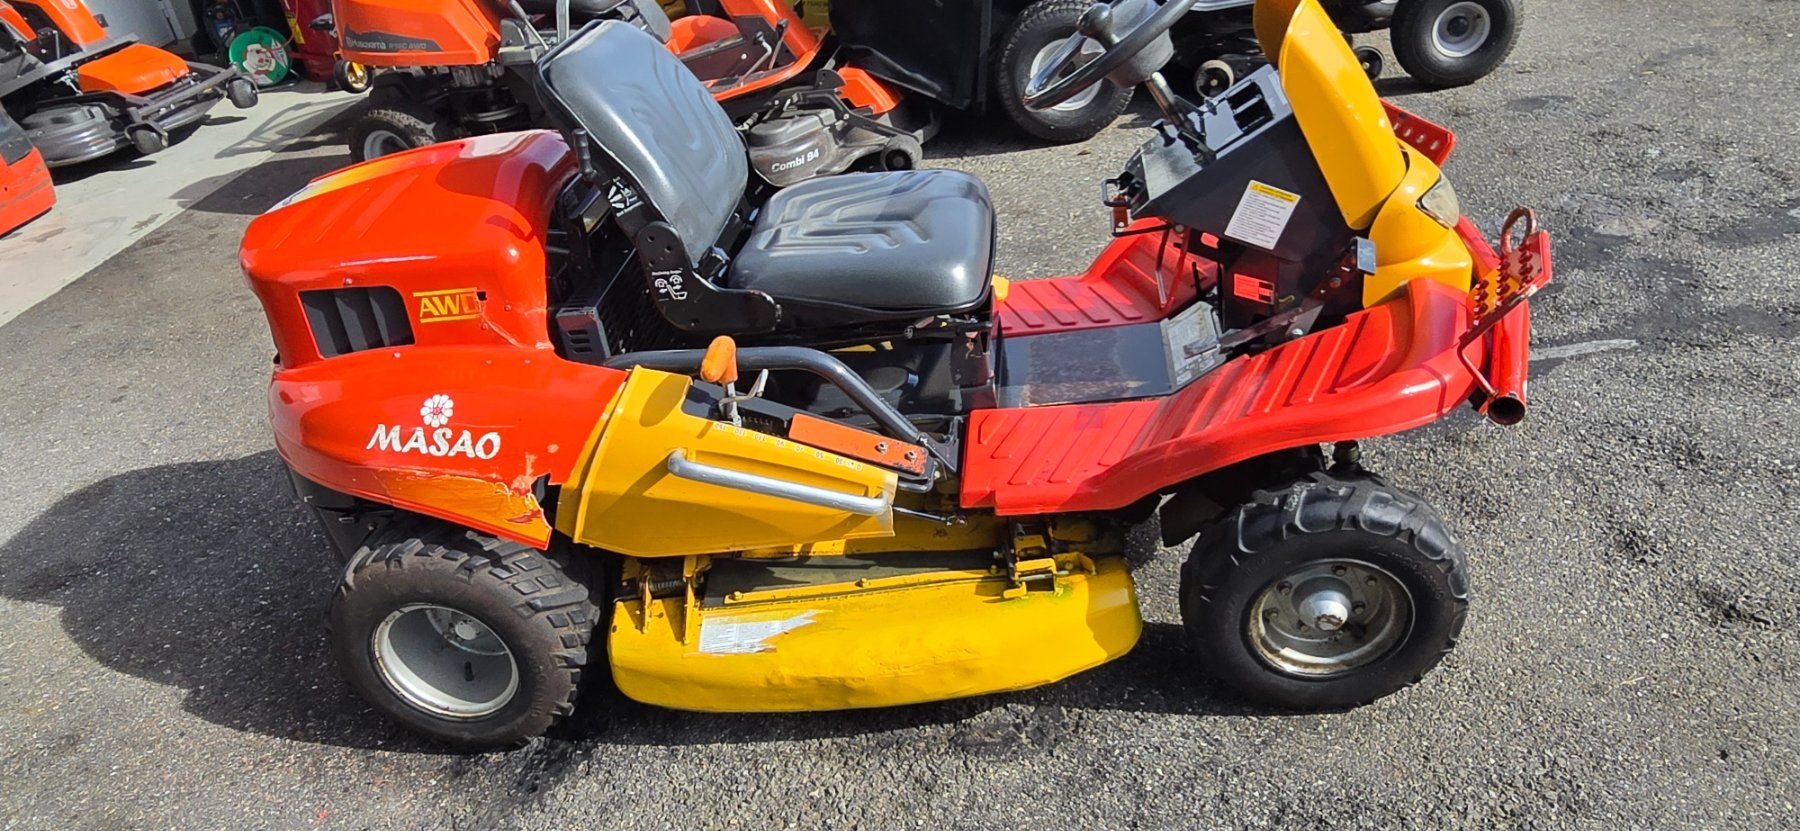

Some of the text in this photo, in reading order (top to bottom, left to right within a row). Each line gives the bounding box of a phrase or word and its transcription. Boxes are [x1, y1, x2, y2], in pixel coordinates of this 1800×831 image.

[772, 155, 805, 172] Combi
[420, 294, 482, 317] AWD
[366, 424, 500, 459] MASAO
